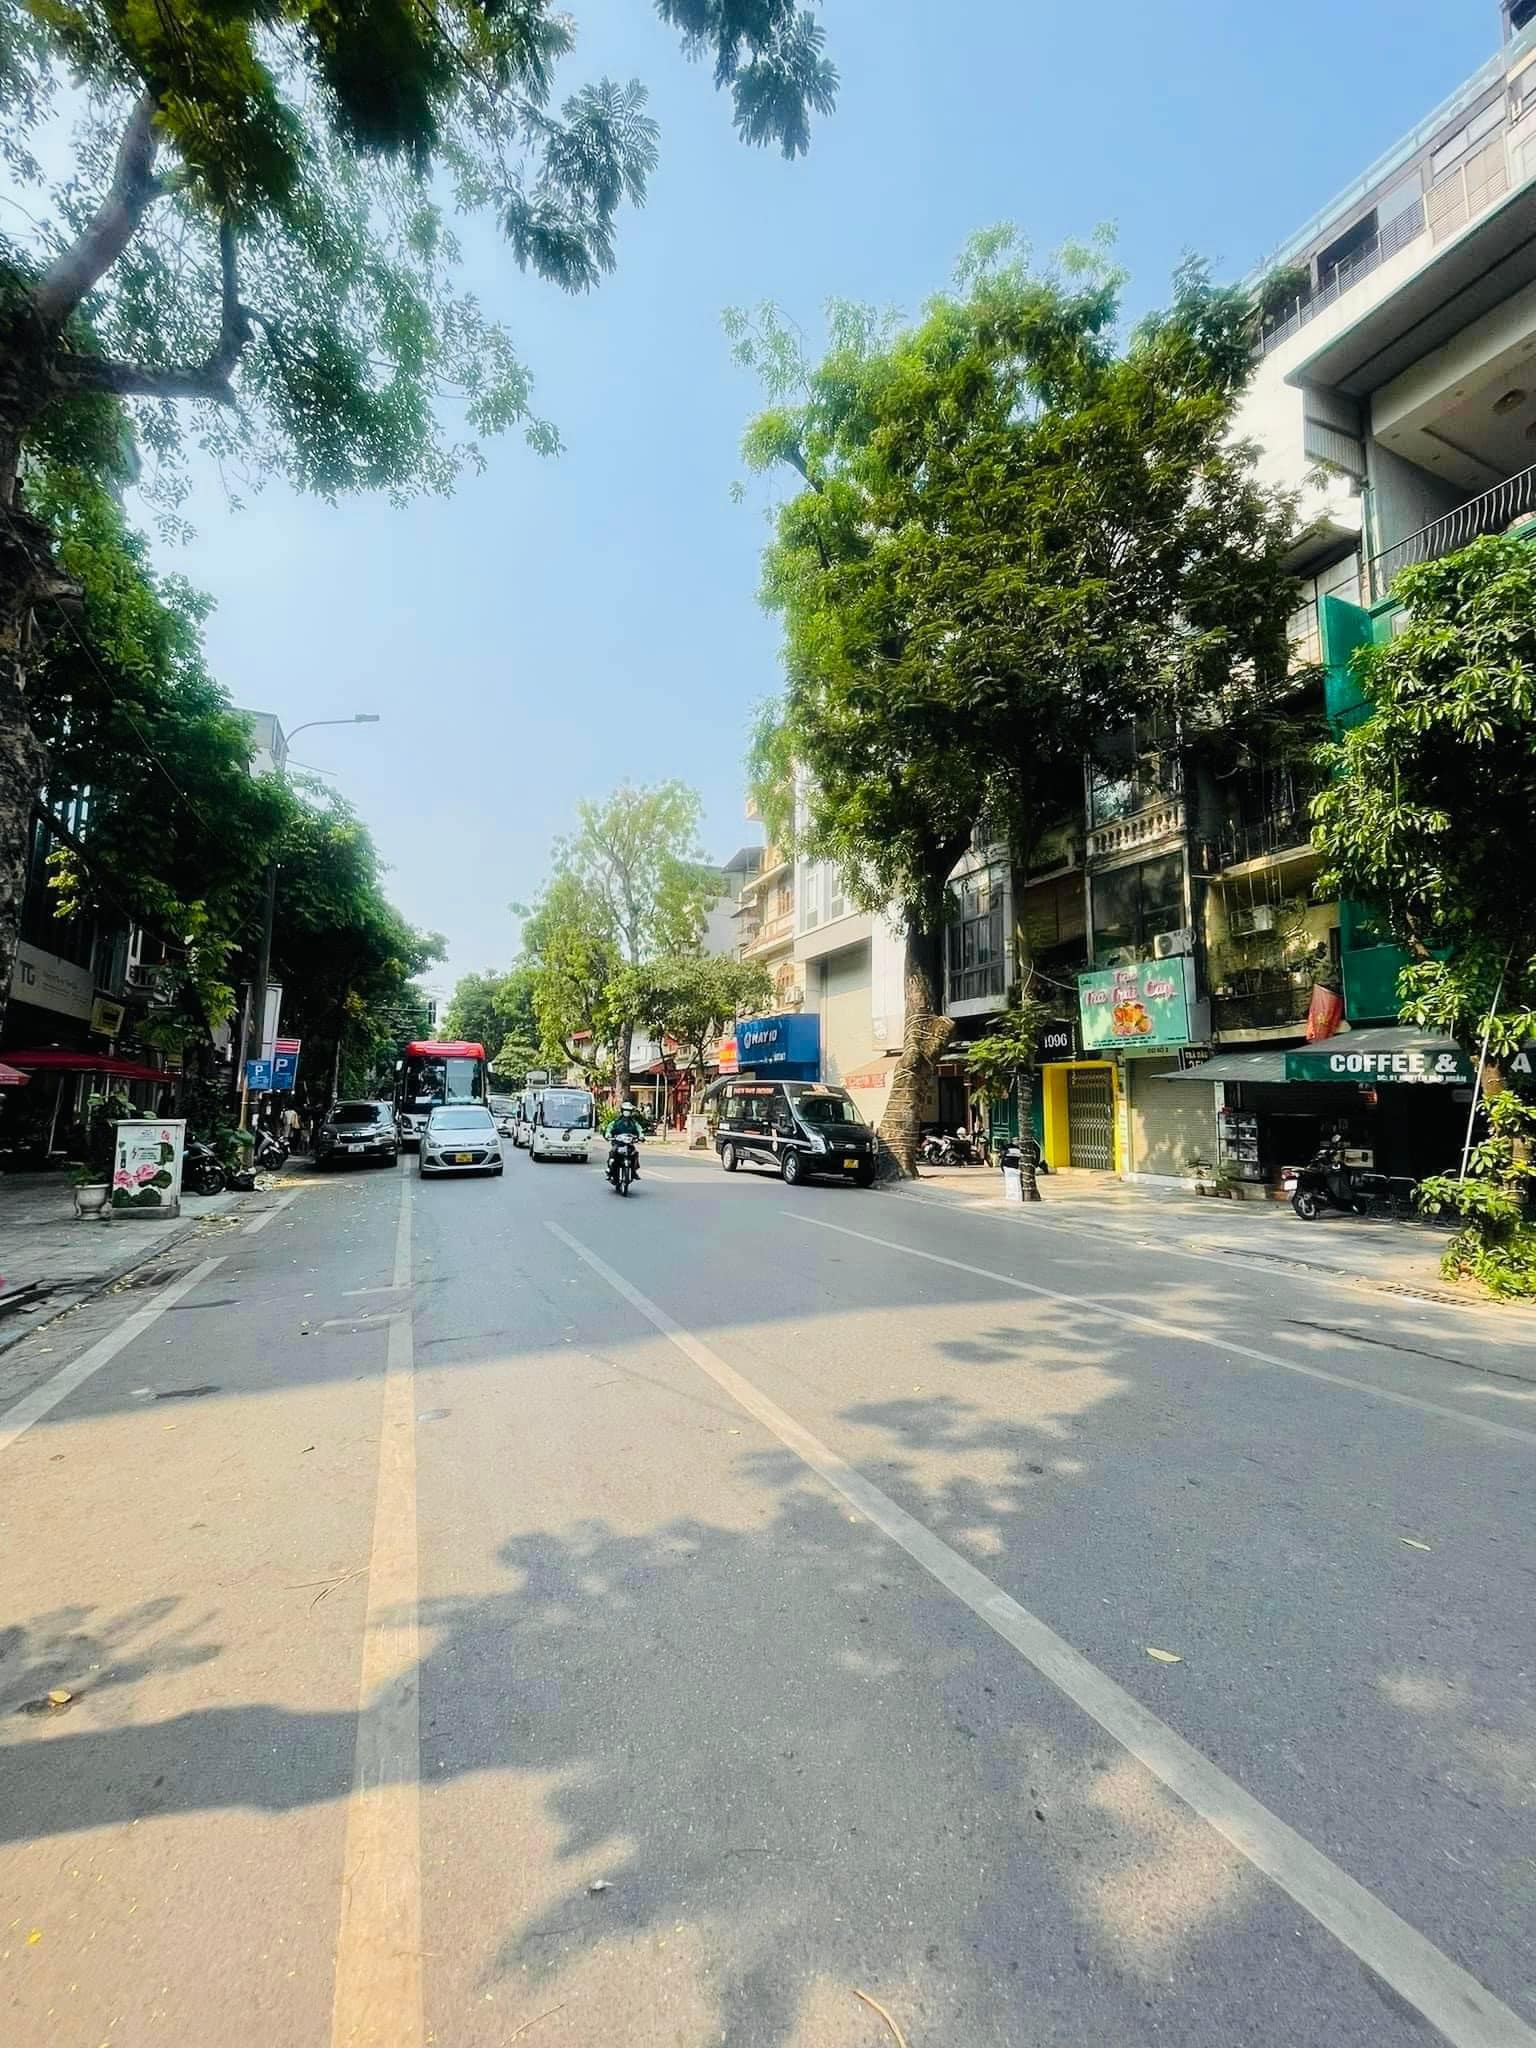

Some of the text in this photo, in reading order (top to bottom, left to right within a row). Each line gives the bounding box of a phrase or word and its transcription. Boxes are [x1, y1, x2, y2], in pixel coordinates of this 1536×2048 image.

[255, 1065, 264, 1076] P
[274, 1058, 288, 1073] P
[1330, 1053, 1425, 1073] COFFEE
[1434, 1053, 1458, 1073] &
